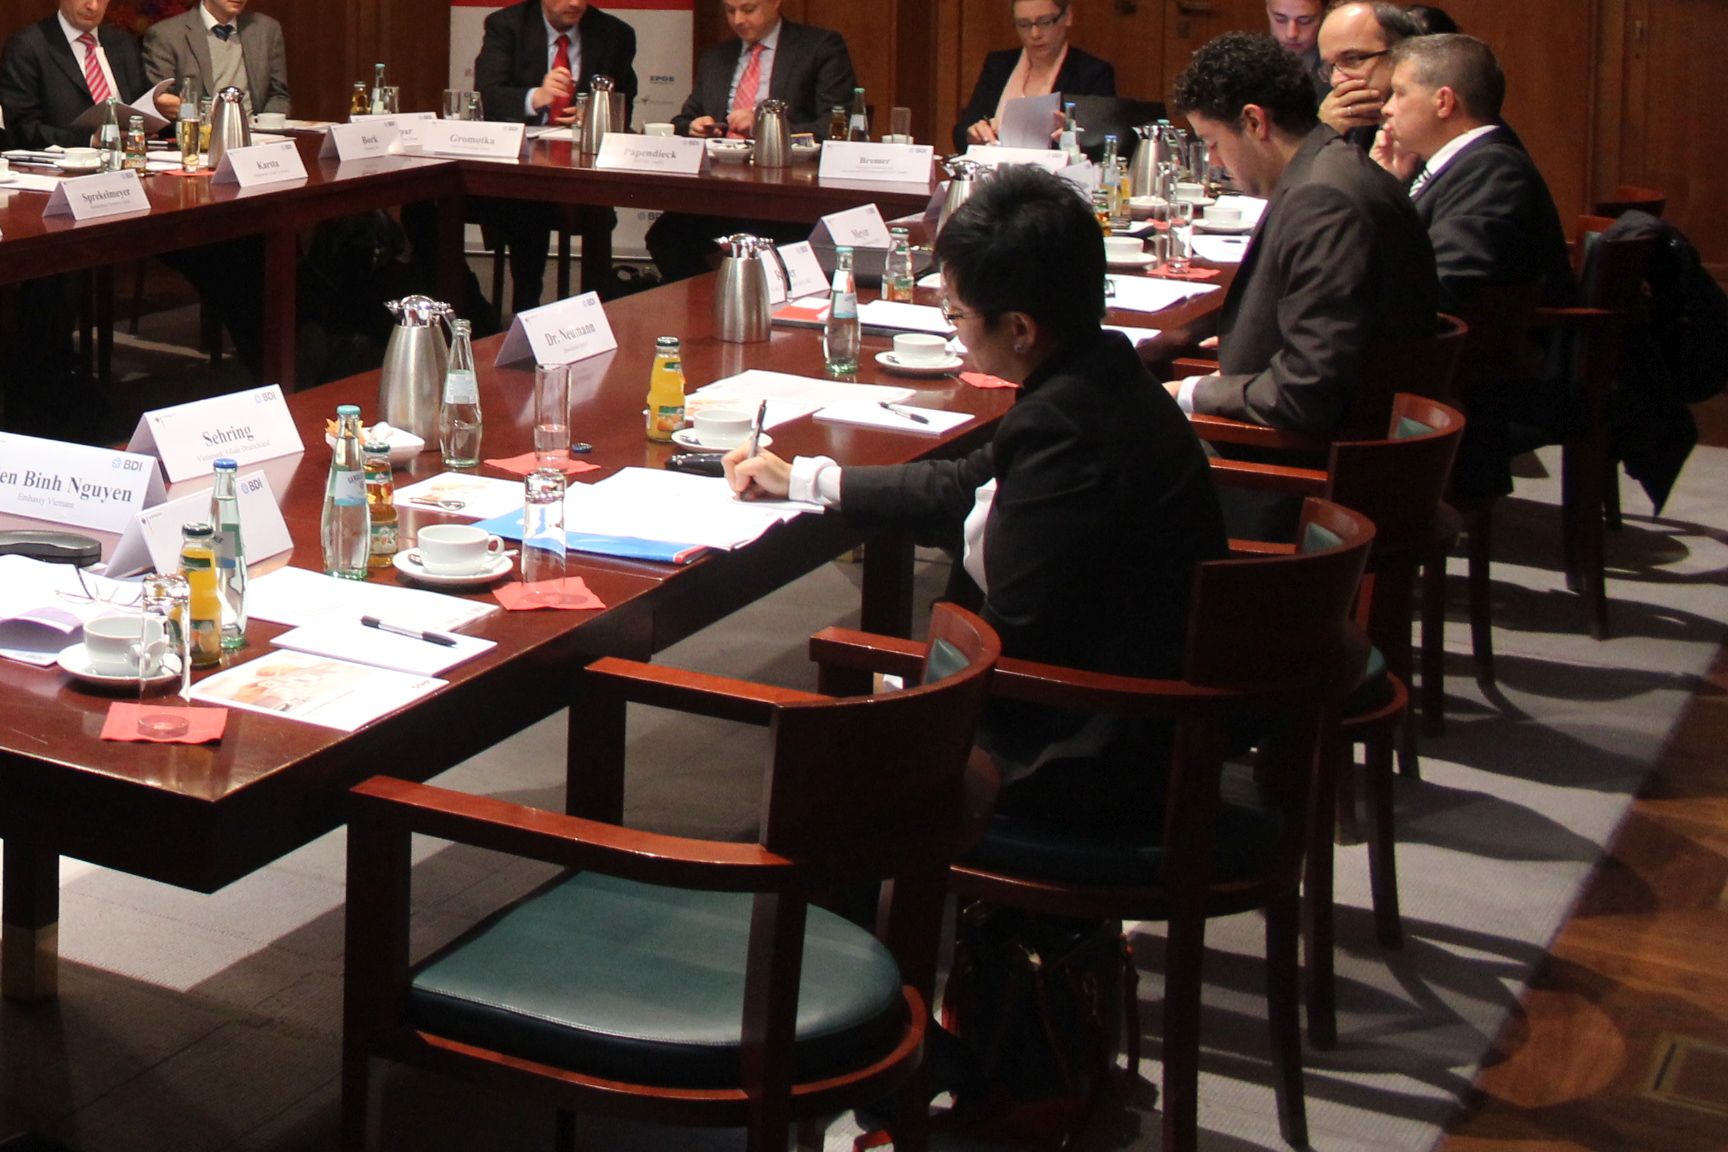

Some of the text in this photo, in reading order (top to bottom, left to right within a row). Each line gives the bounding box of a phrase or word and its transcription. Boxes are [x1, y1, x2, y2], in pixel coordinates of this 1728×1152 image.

[262, 391, 277, 402] BDI
[202, 426, 255, 446] Sehring
[123, 459, 143, 472] BDI
[24, 470, 62, 492] Binh
[67, 477, 132, 503] Nguyen
[247, 478, 263, 492] BDI
